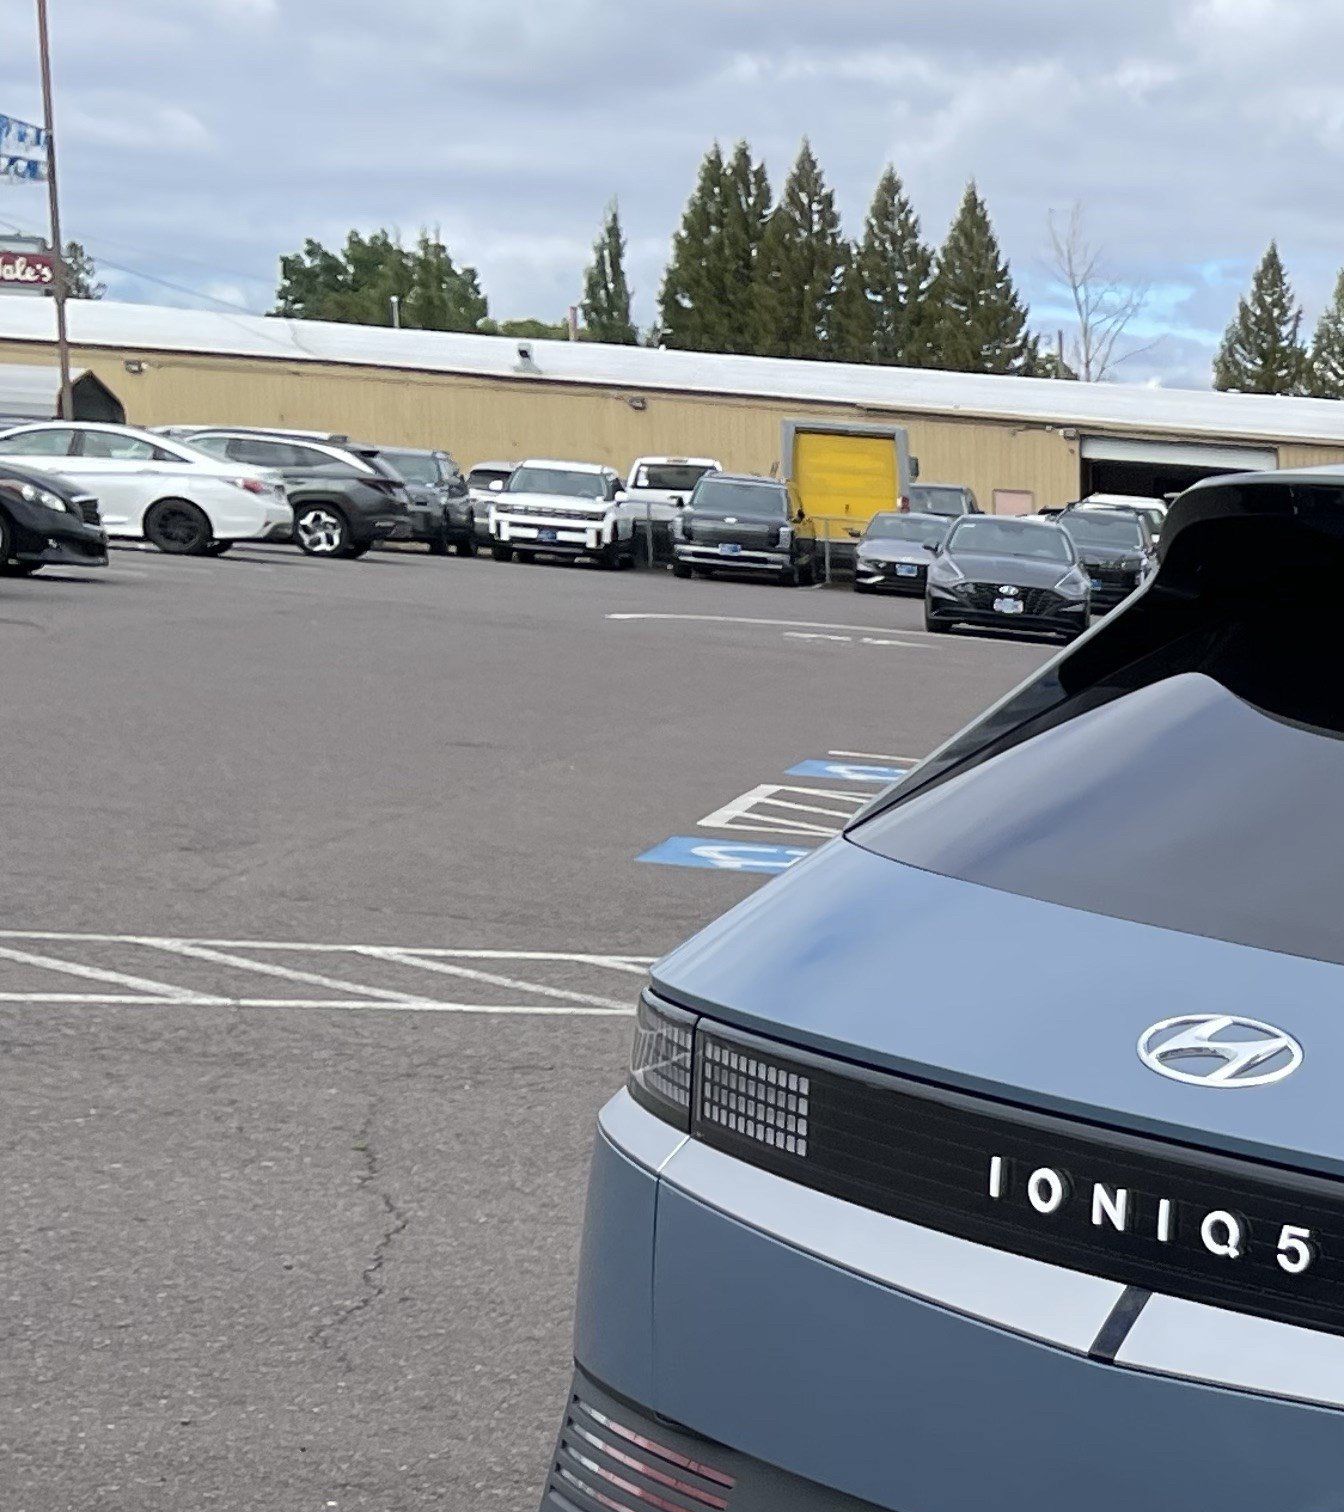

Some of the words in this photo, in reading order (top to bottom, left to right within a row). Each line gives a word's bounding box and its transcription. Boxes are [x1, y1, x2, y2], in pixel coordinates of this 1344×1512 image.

[0, 254, 52, 284] ale's
[990, 1156, 1240, 1259] IONIQ
[1276, 1225, 1311, 1273] 5
